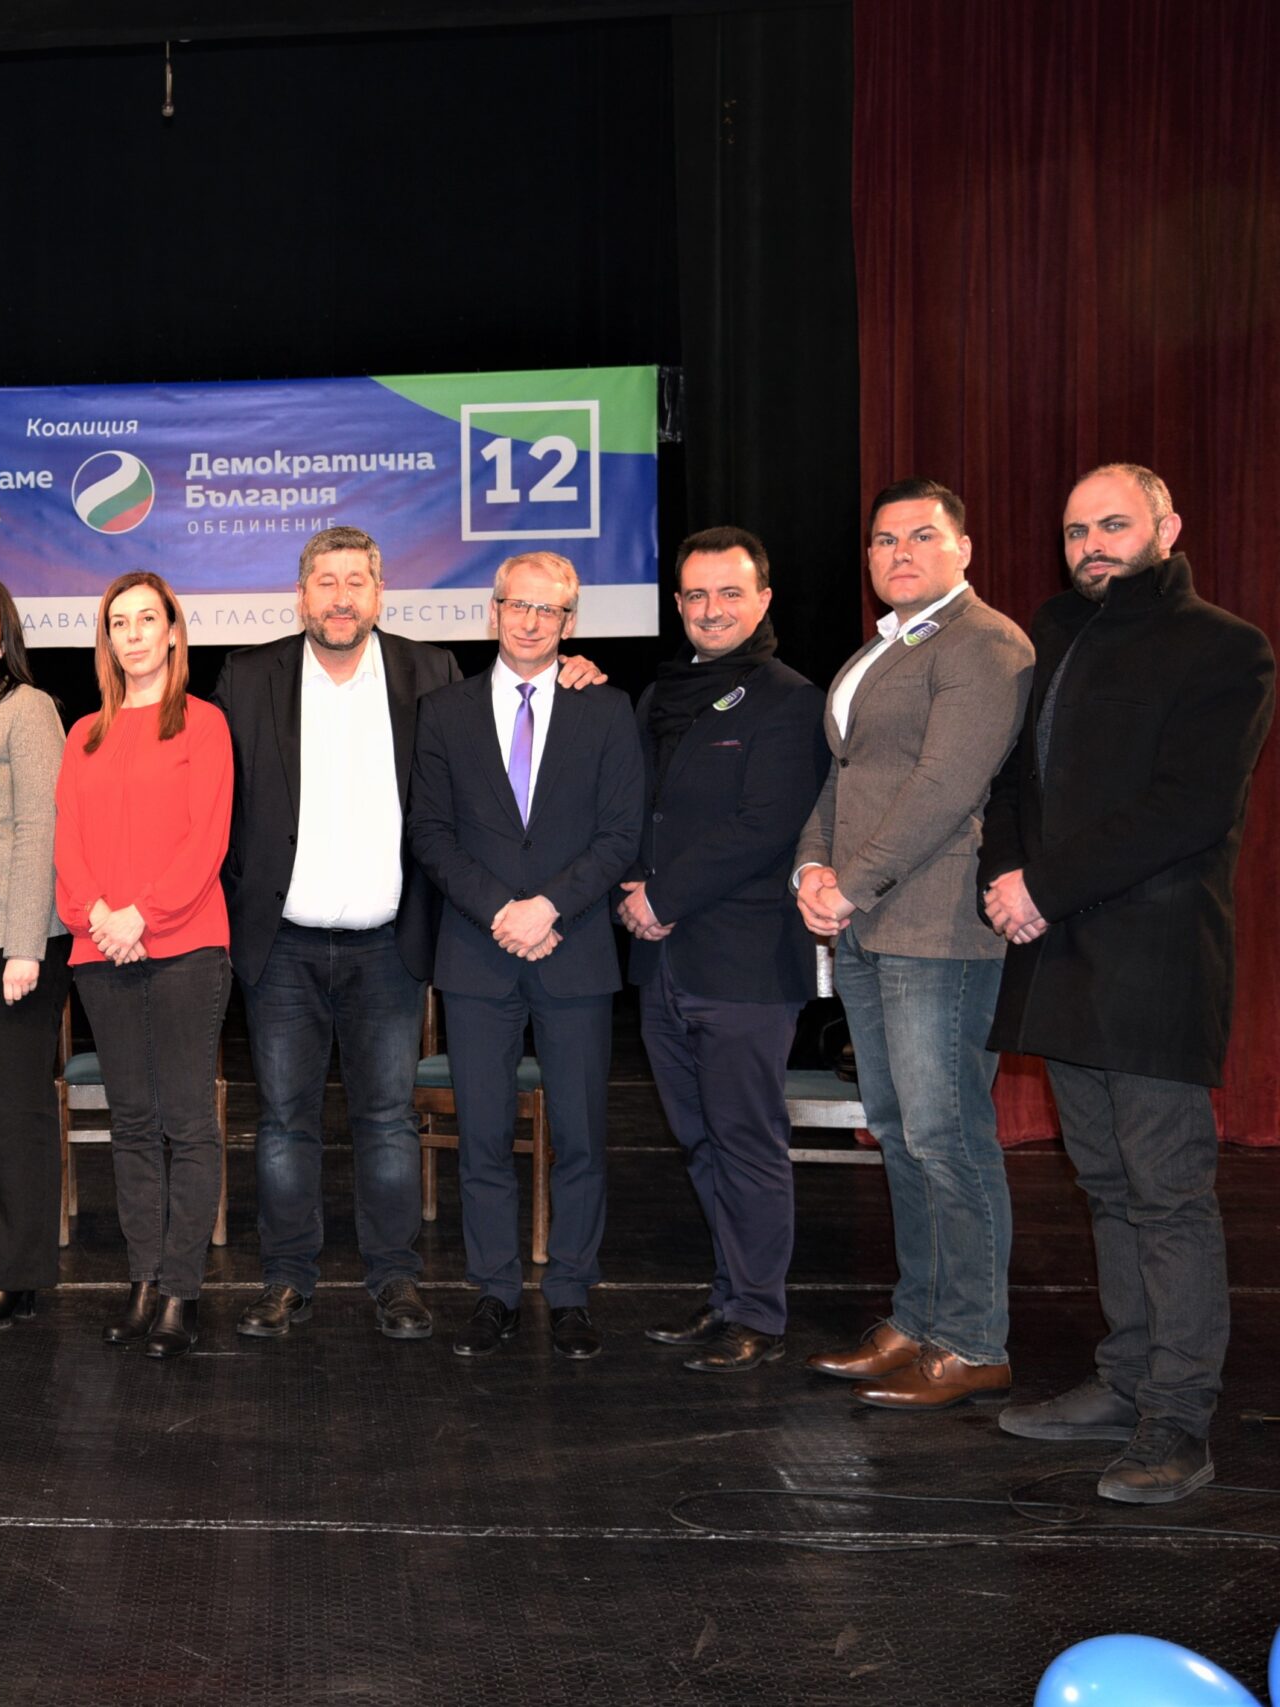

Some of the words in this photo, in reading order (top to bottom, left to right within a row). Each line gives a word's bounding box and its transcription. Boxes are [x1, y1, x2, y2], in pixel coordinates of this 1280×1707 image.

[26, 417, 138, 439] Коалиция
[186, 449, 435, 479] Демократична
[480, 435, 578, 504] 12
[186, 483, 337, 510] България
[187, 517, 337, 535] ОБЕДИНЕНИЕ
[22, 612, 99, 631] ДАВАН
[189, 611, 202, 625] А
[215, 608, 295, 625] ГЛАСО
[386, 604, 484, 622] РЕСТЪП
